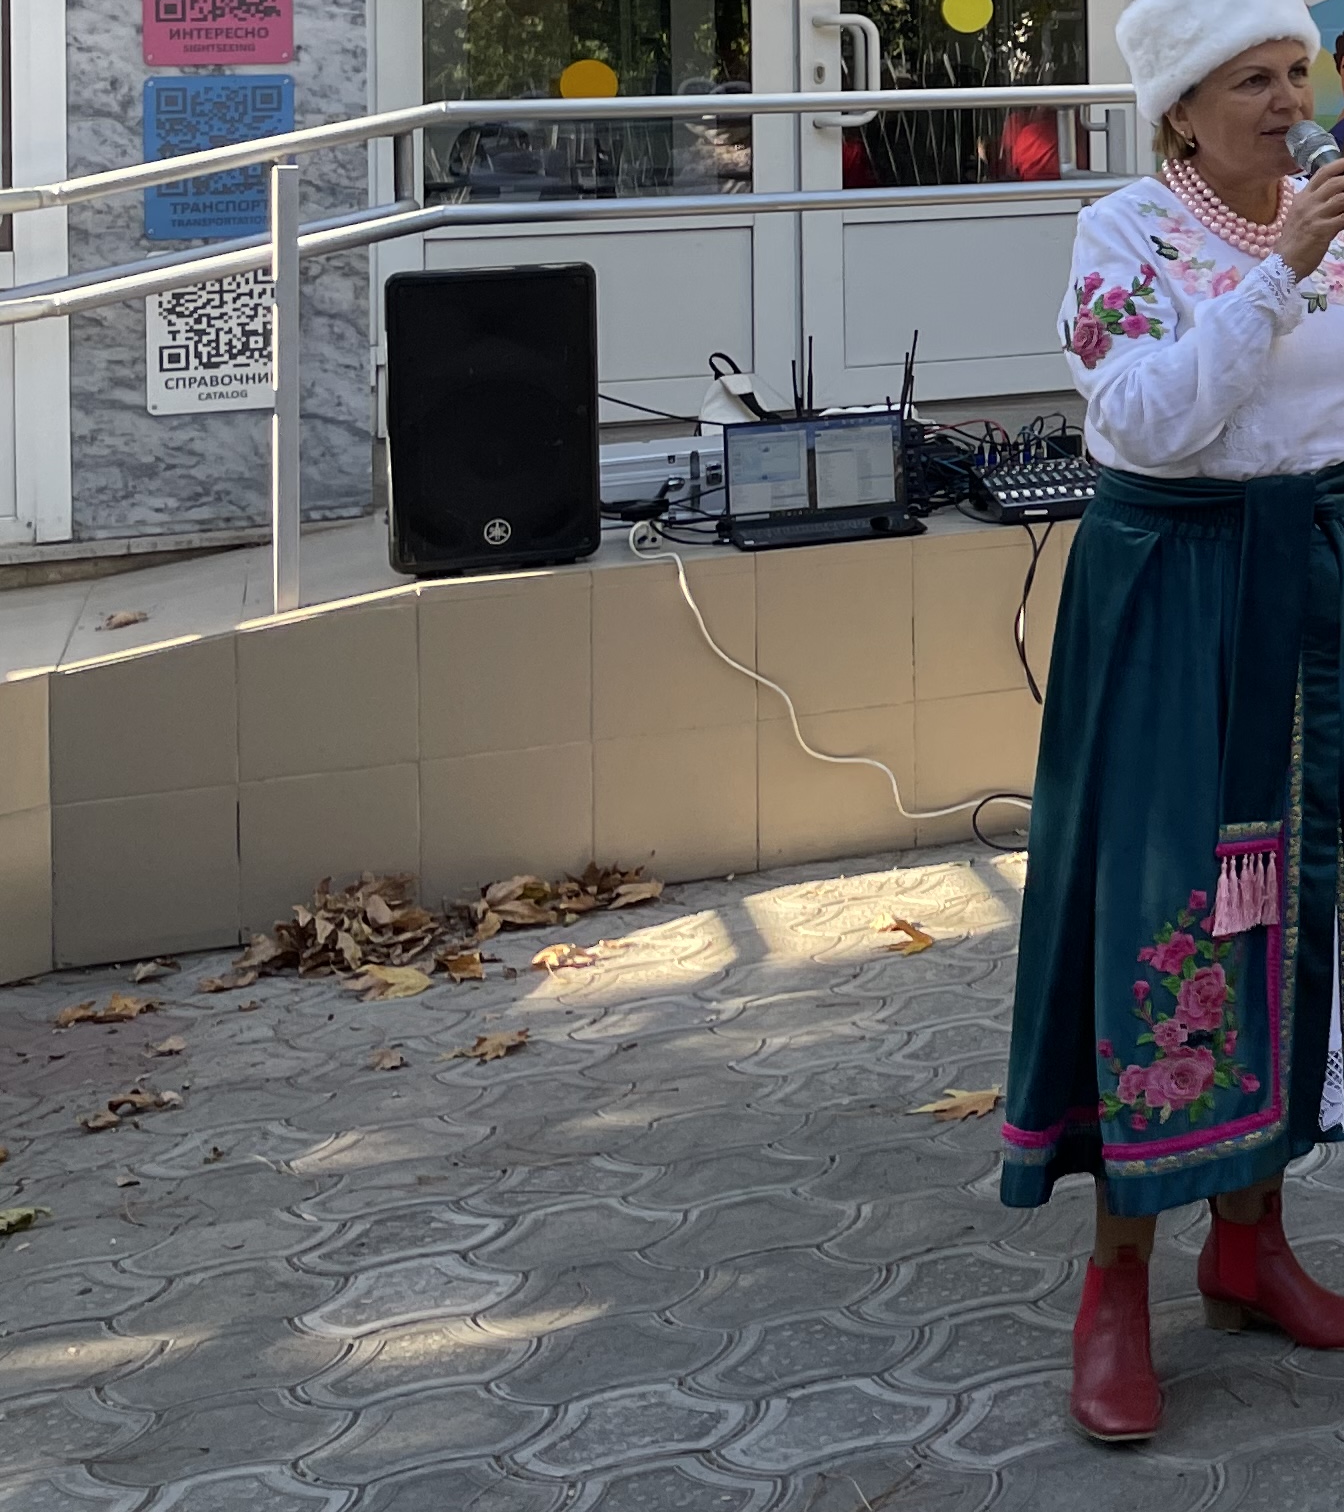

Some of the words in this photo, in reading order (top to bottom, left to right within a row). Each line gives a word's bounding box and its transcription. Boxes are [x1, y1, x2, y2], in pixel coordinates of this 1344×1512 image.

[169, 27, 269, 40] ИНТЕРЕСНО
[183, 43, 256, 53] SIGHTSEEING
[165, 372, 273, 390] СПРАВОЧНИ
[198, 389, 249, 401] CATALOG
